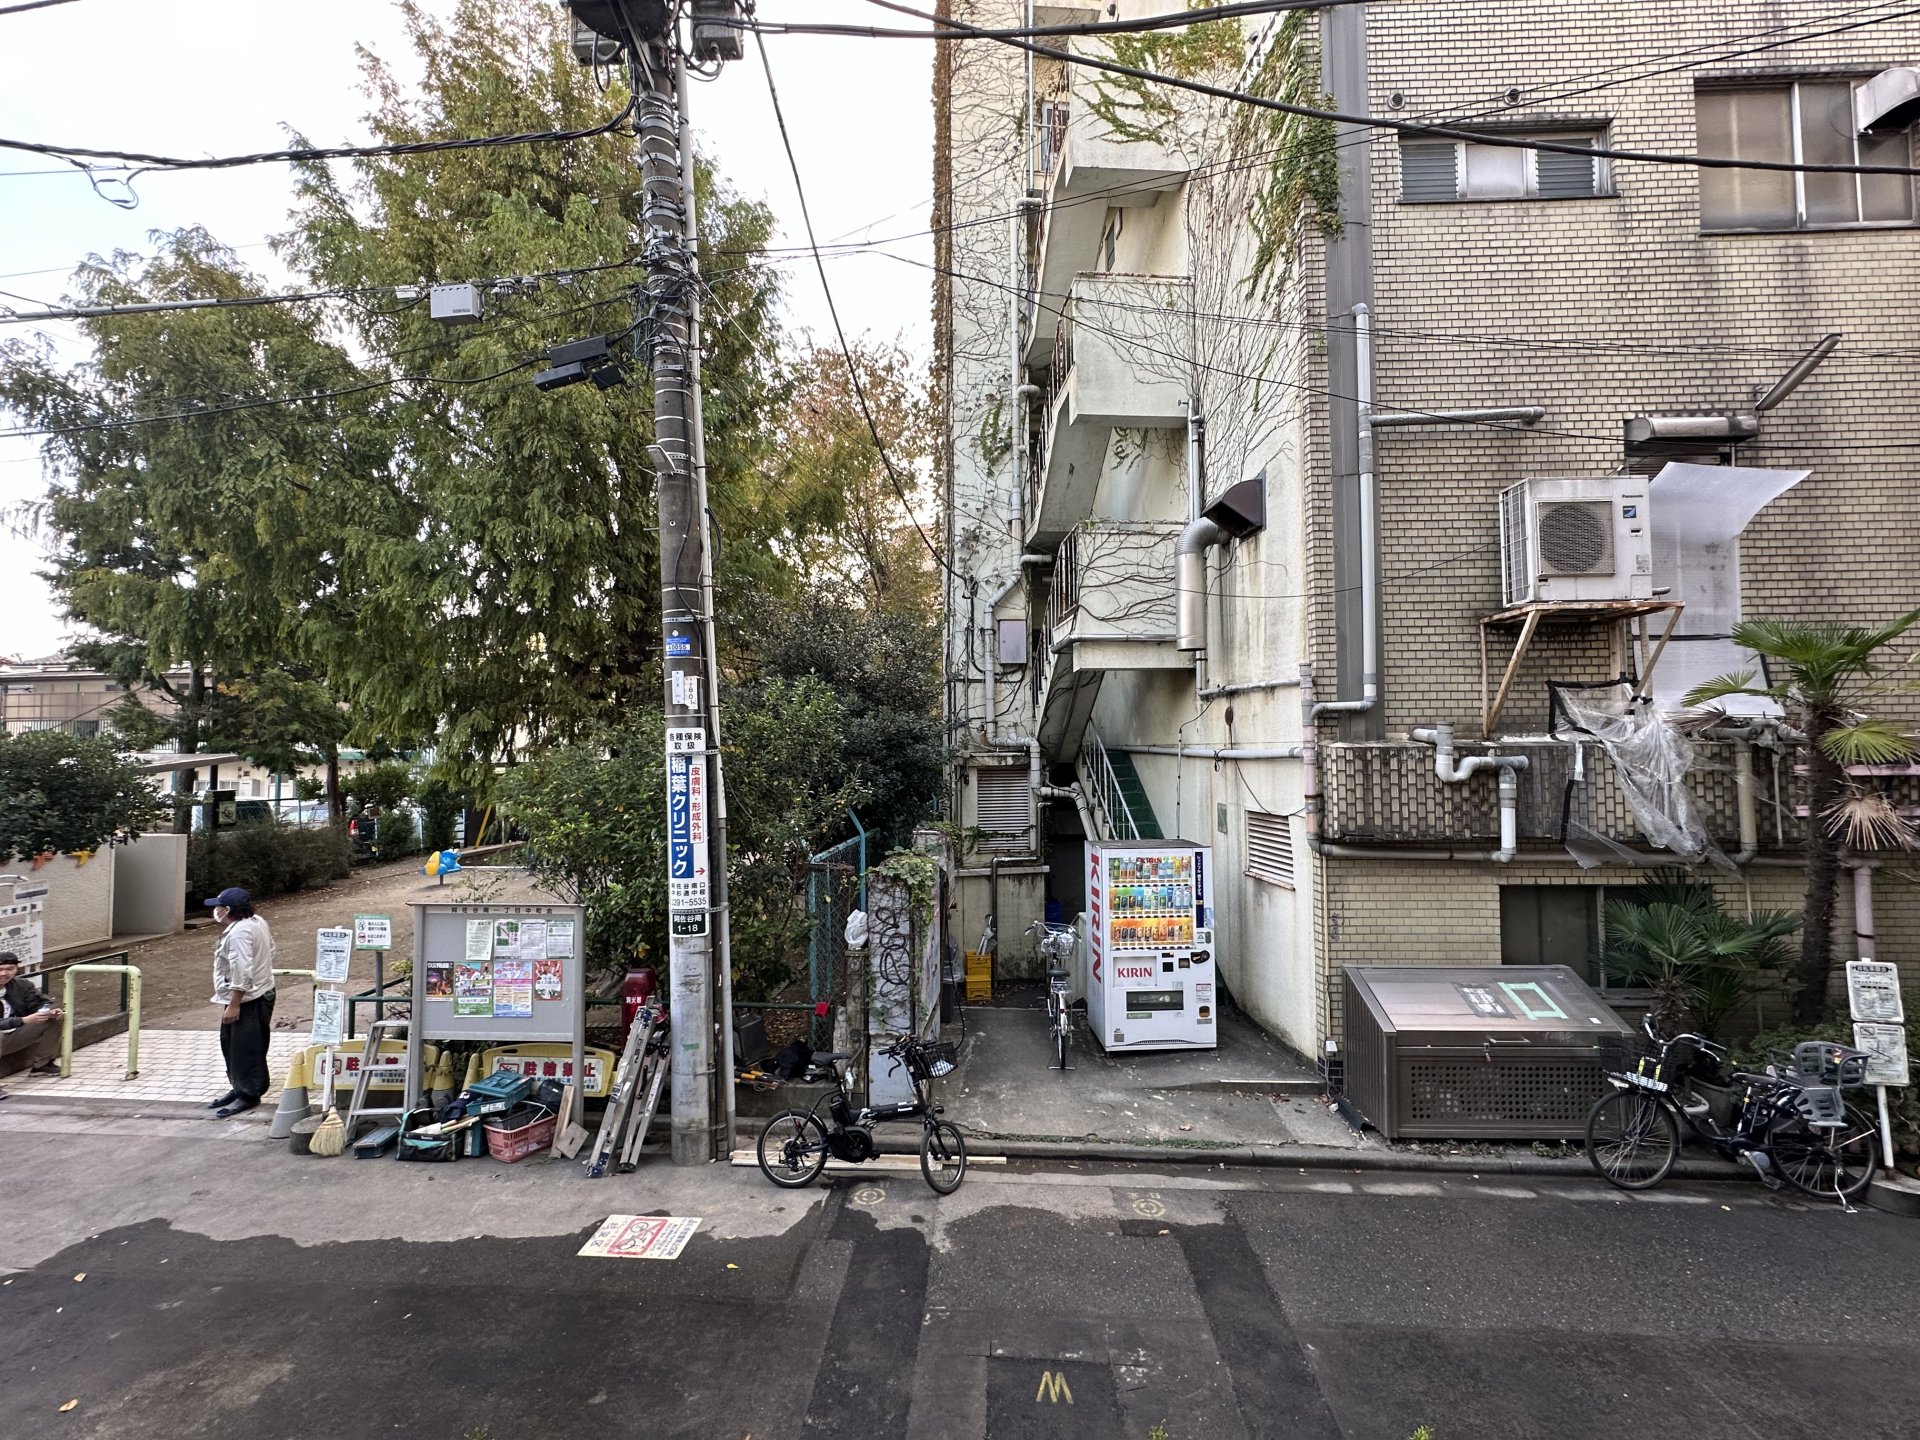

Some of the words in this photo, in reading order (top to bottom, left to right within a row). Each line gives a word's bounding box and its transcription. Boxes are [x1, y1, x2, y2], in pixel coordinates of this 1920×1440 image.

[669, 732, 702, 742] 各種保険
[673, 741, 696, 750] 取扱
[691, 766, 702, 841] 皮膚科・形成外科
[671, 754, 688, 877] 稲葉クリニック
[1090, 852, 1103, 985] KIRIN
[677, 924, 699, 933] 1-18
[1117, 967, 1153, 979] KIRIN
[625, 996, 642, 1004] 消火器
[522, 1060, 596, 1078] 駐輪禁止
